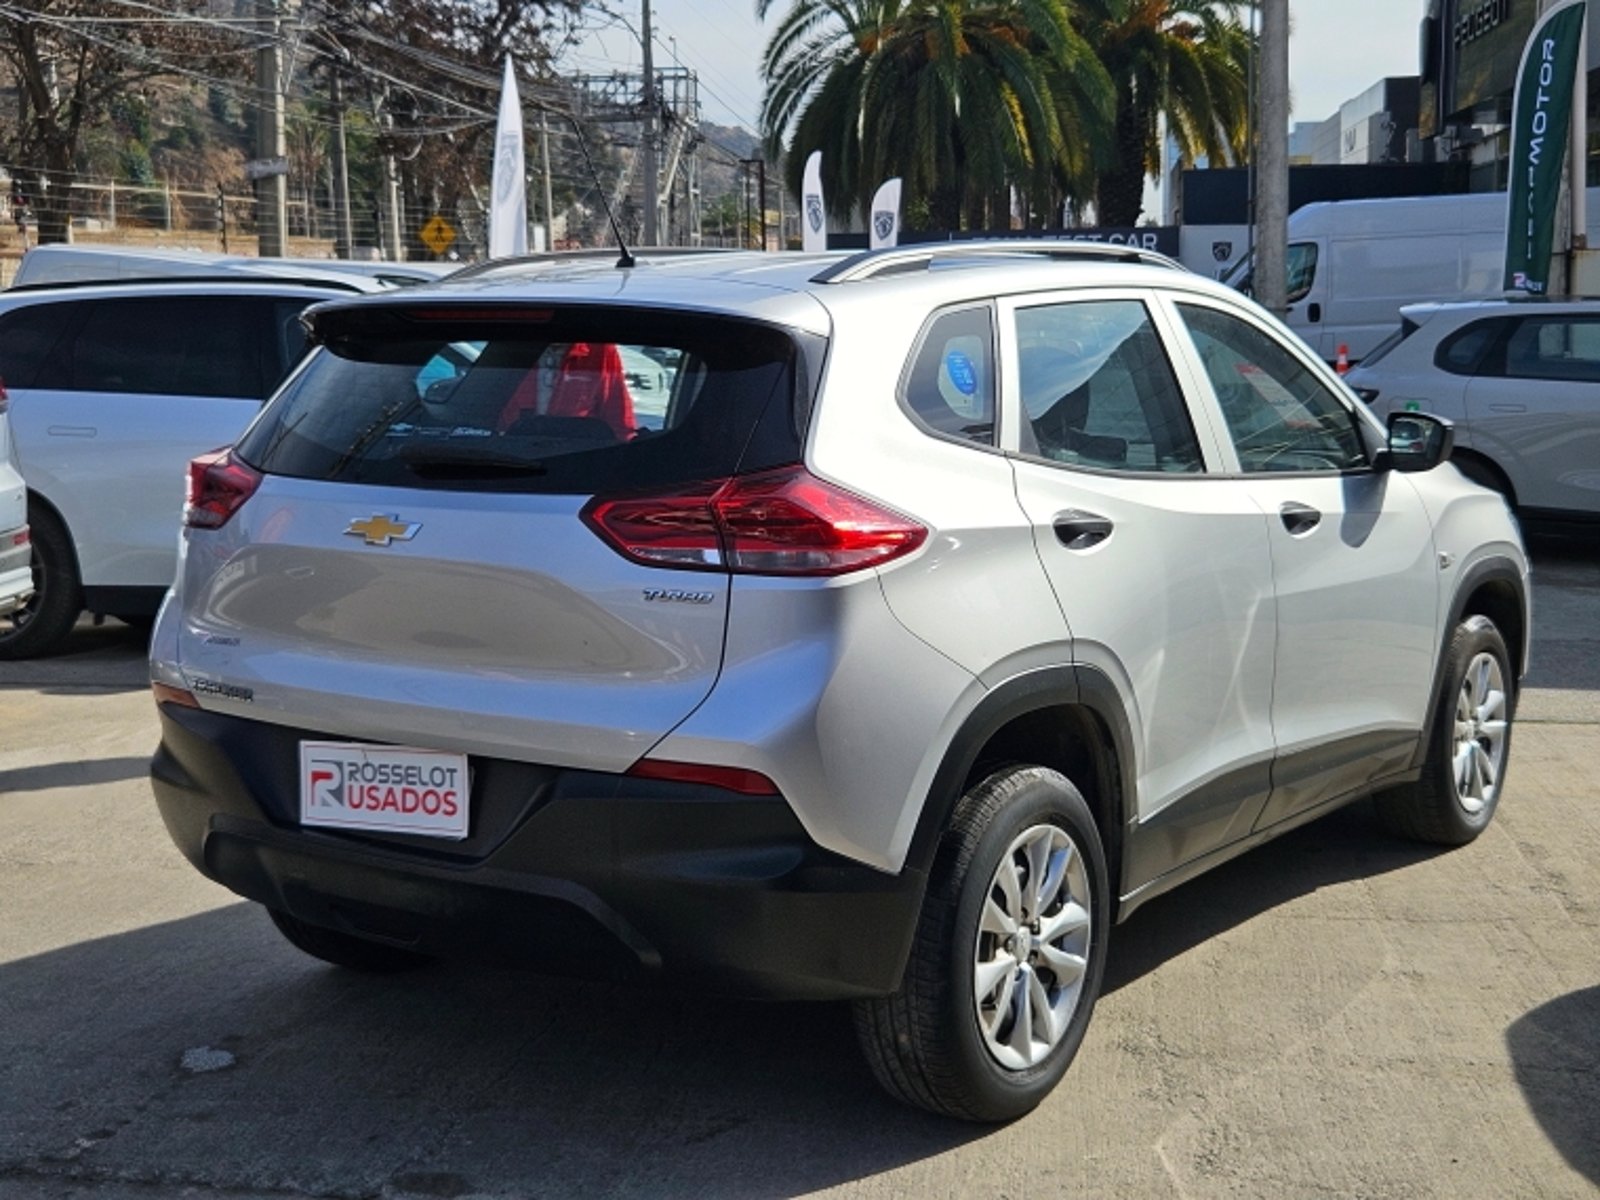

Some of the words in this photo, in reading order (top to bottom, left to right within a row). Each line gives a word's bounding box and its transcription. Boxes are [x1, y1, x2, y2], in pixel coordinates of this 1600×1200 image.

[1108, 232, 1158, 250] CAR
[347, 761, 458, 788] ROSSELOT
[349, 785, 458, 816] USADOS
